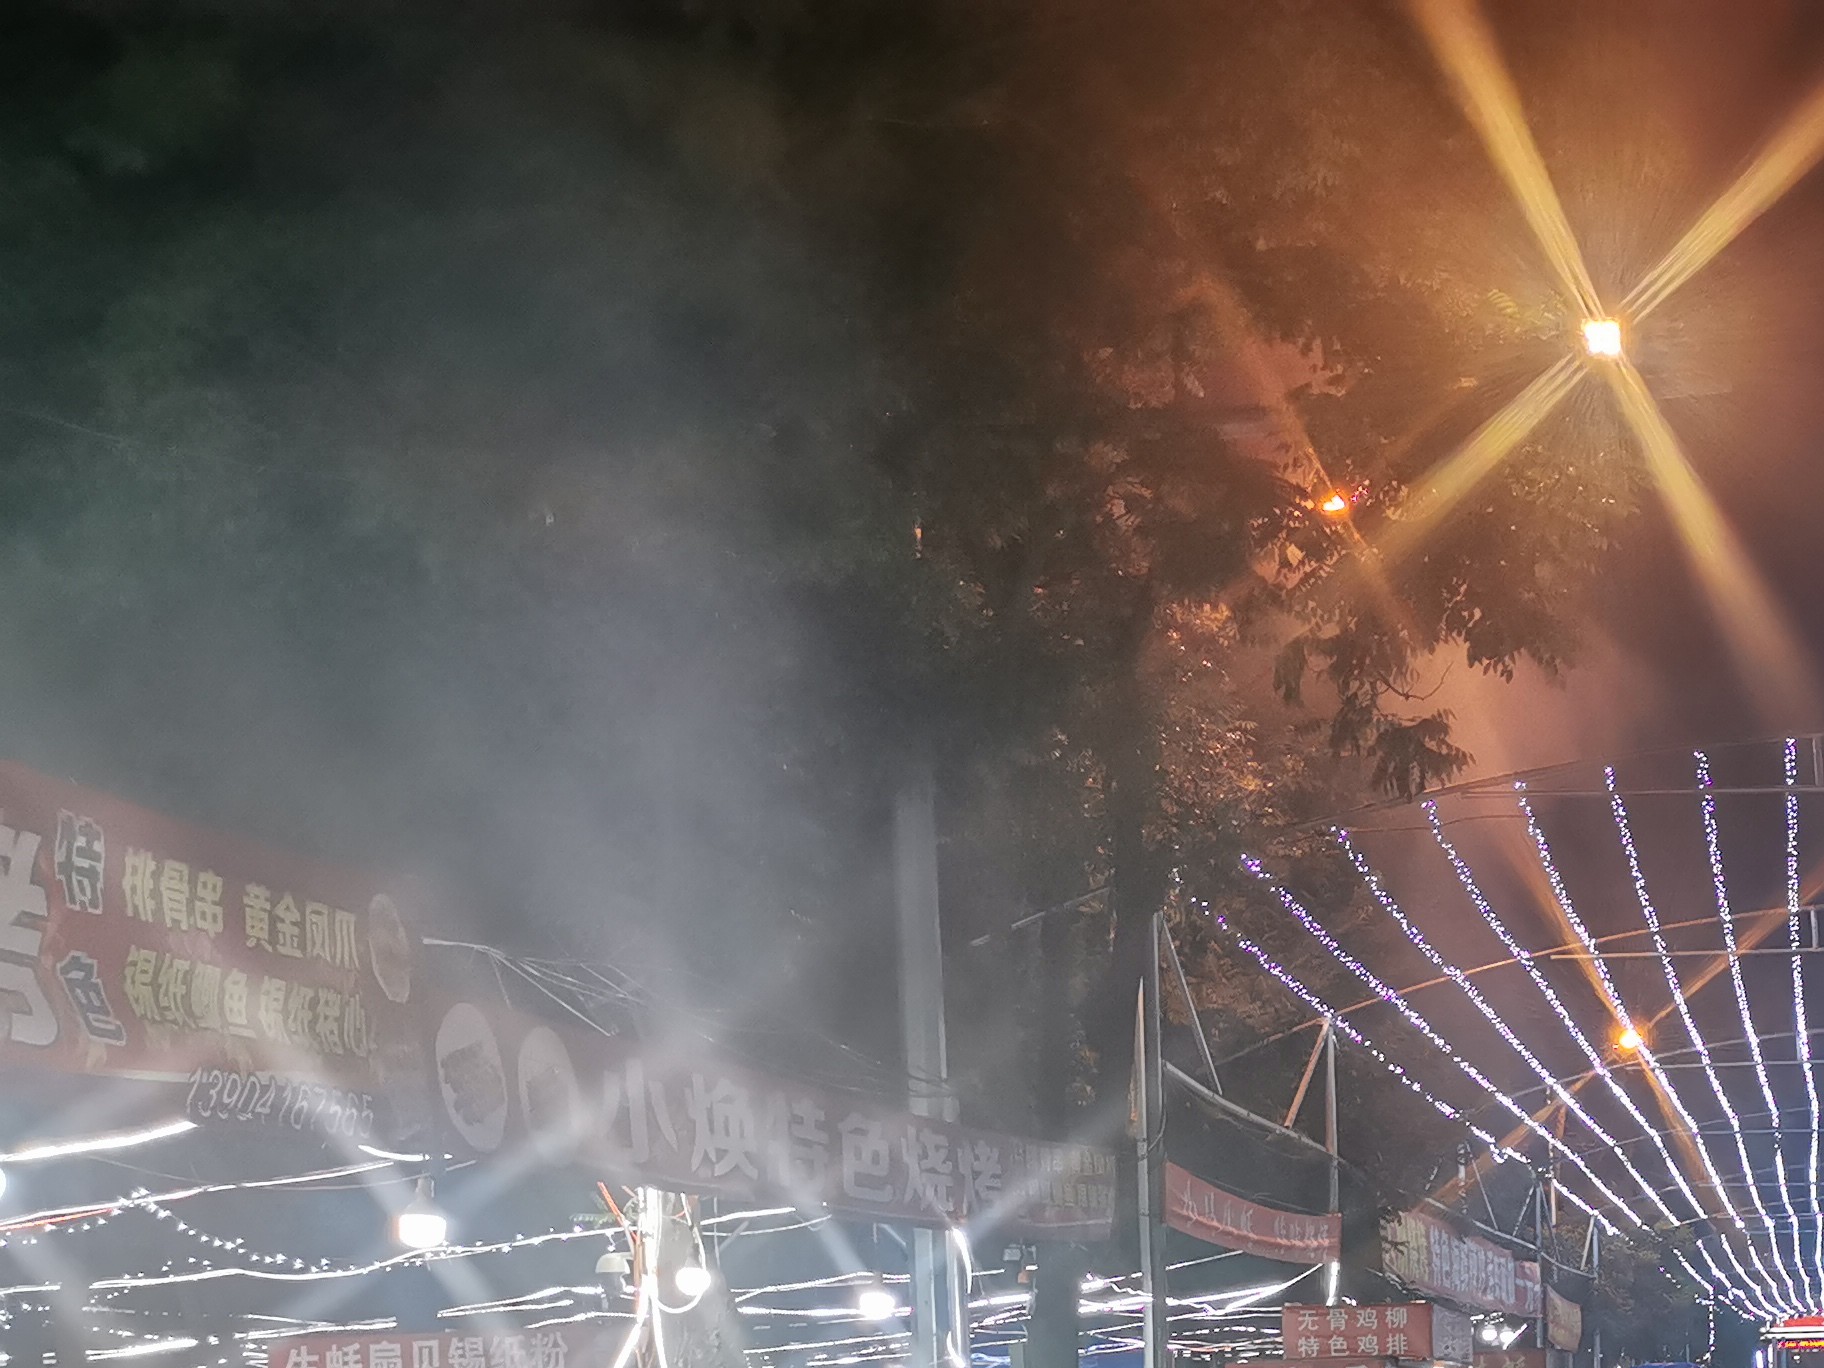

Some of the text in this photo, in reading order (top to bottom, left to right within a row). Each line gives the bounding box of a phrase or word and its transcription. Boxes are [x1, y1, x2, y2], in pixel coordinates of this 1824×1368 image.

[55, 808, 127, 1046] 特色
[123, 848, 359, 970] 排骨串 黄金凤爪
[1297, 1307, 1408, 1331] 无骨鸡柳
[1297, 1334, 1408, 1357] 特色鸡排
